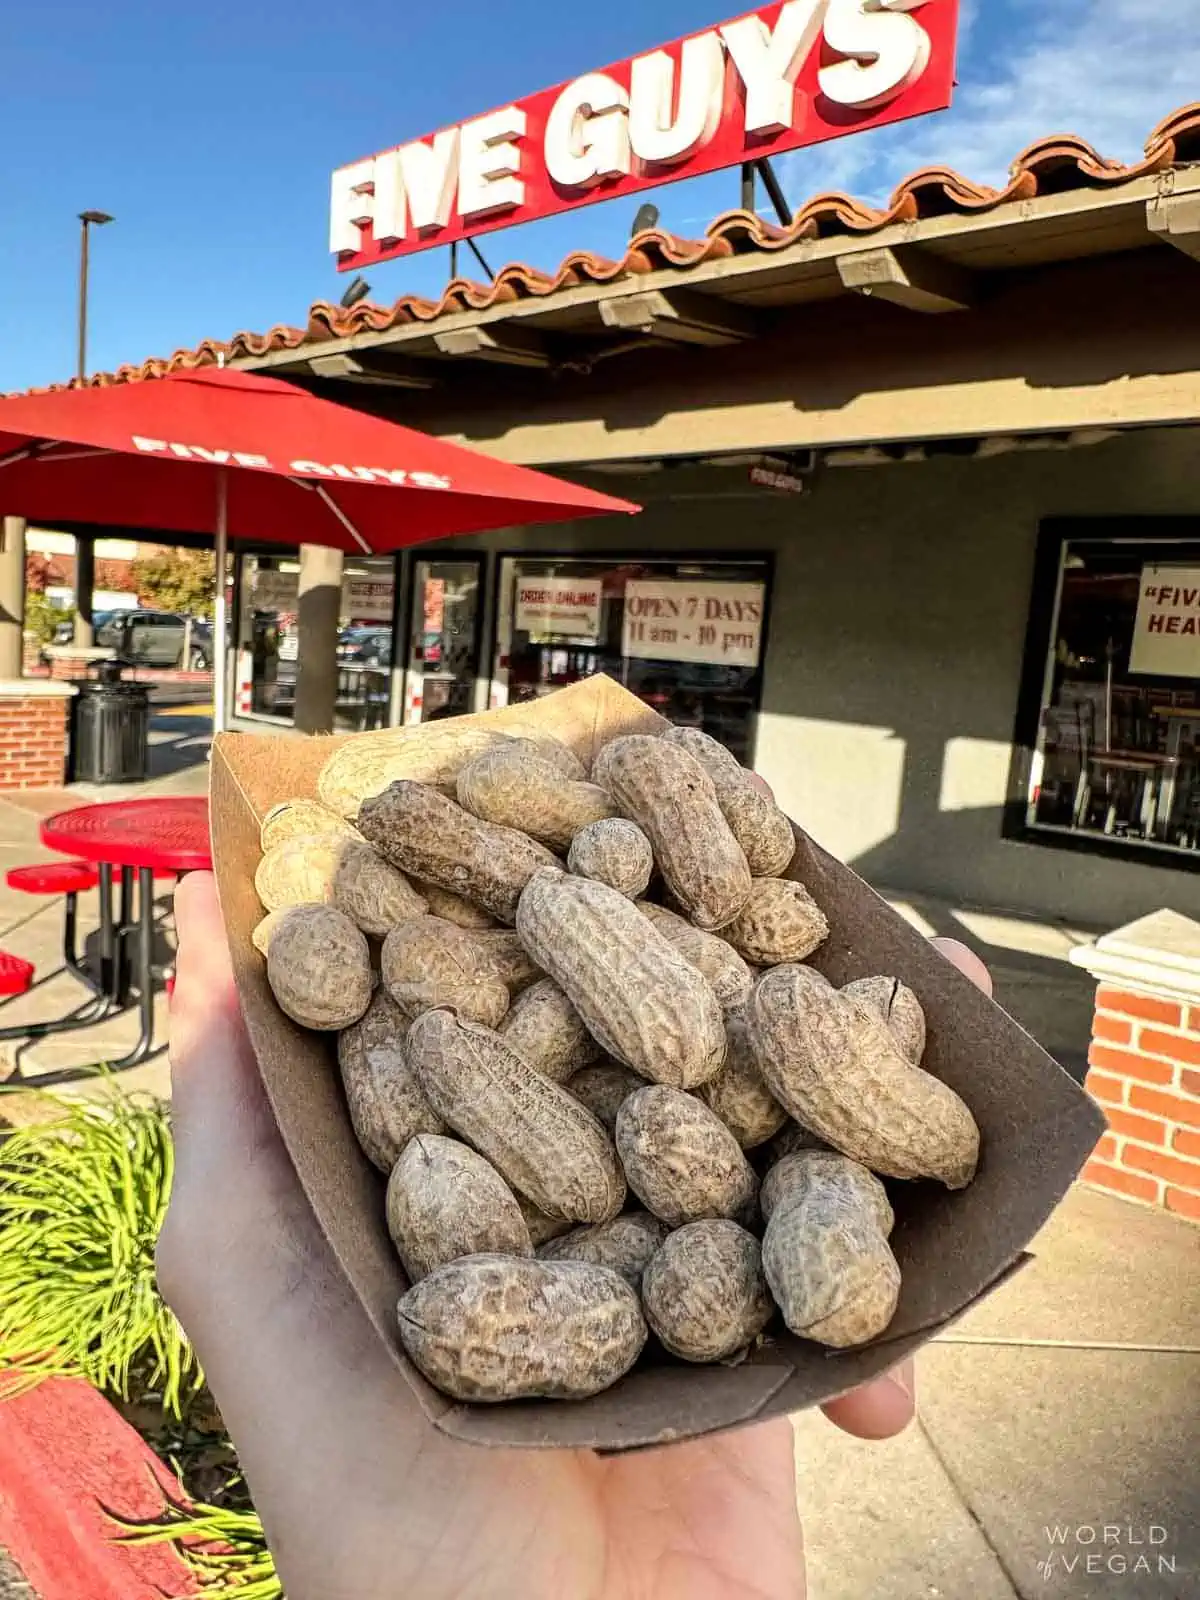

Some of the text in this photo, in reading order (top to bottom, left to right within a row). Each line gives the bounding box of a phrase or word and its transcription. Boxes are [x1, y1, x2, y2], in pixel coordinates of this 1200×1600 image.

[329, 0, 932, 254] FIVE GUYS
[131, 436, 452, 489] FIVE GUYS
[629, 596, 760, 622] OPEN 7 DAYS
[1144, 584, 1200, 606] “FIV
[629, 621, 645, 641] 11
[650, 628, 677, 643] am
[698, 623, 717, 645] 10
[723, 632, 753, 654] pm
[1148, 613, 1200, 635] HEA
